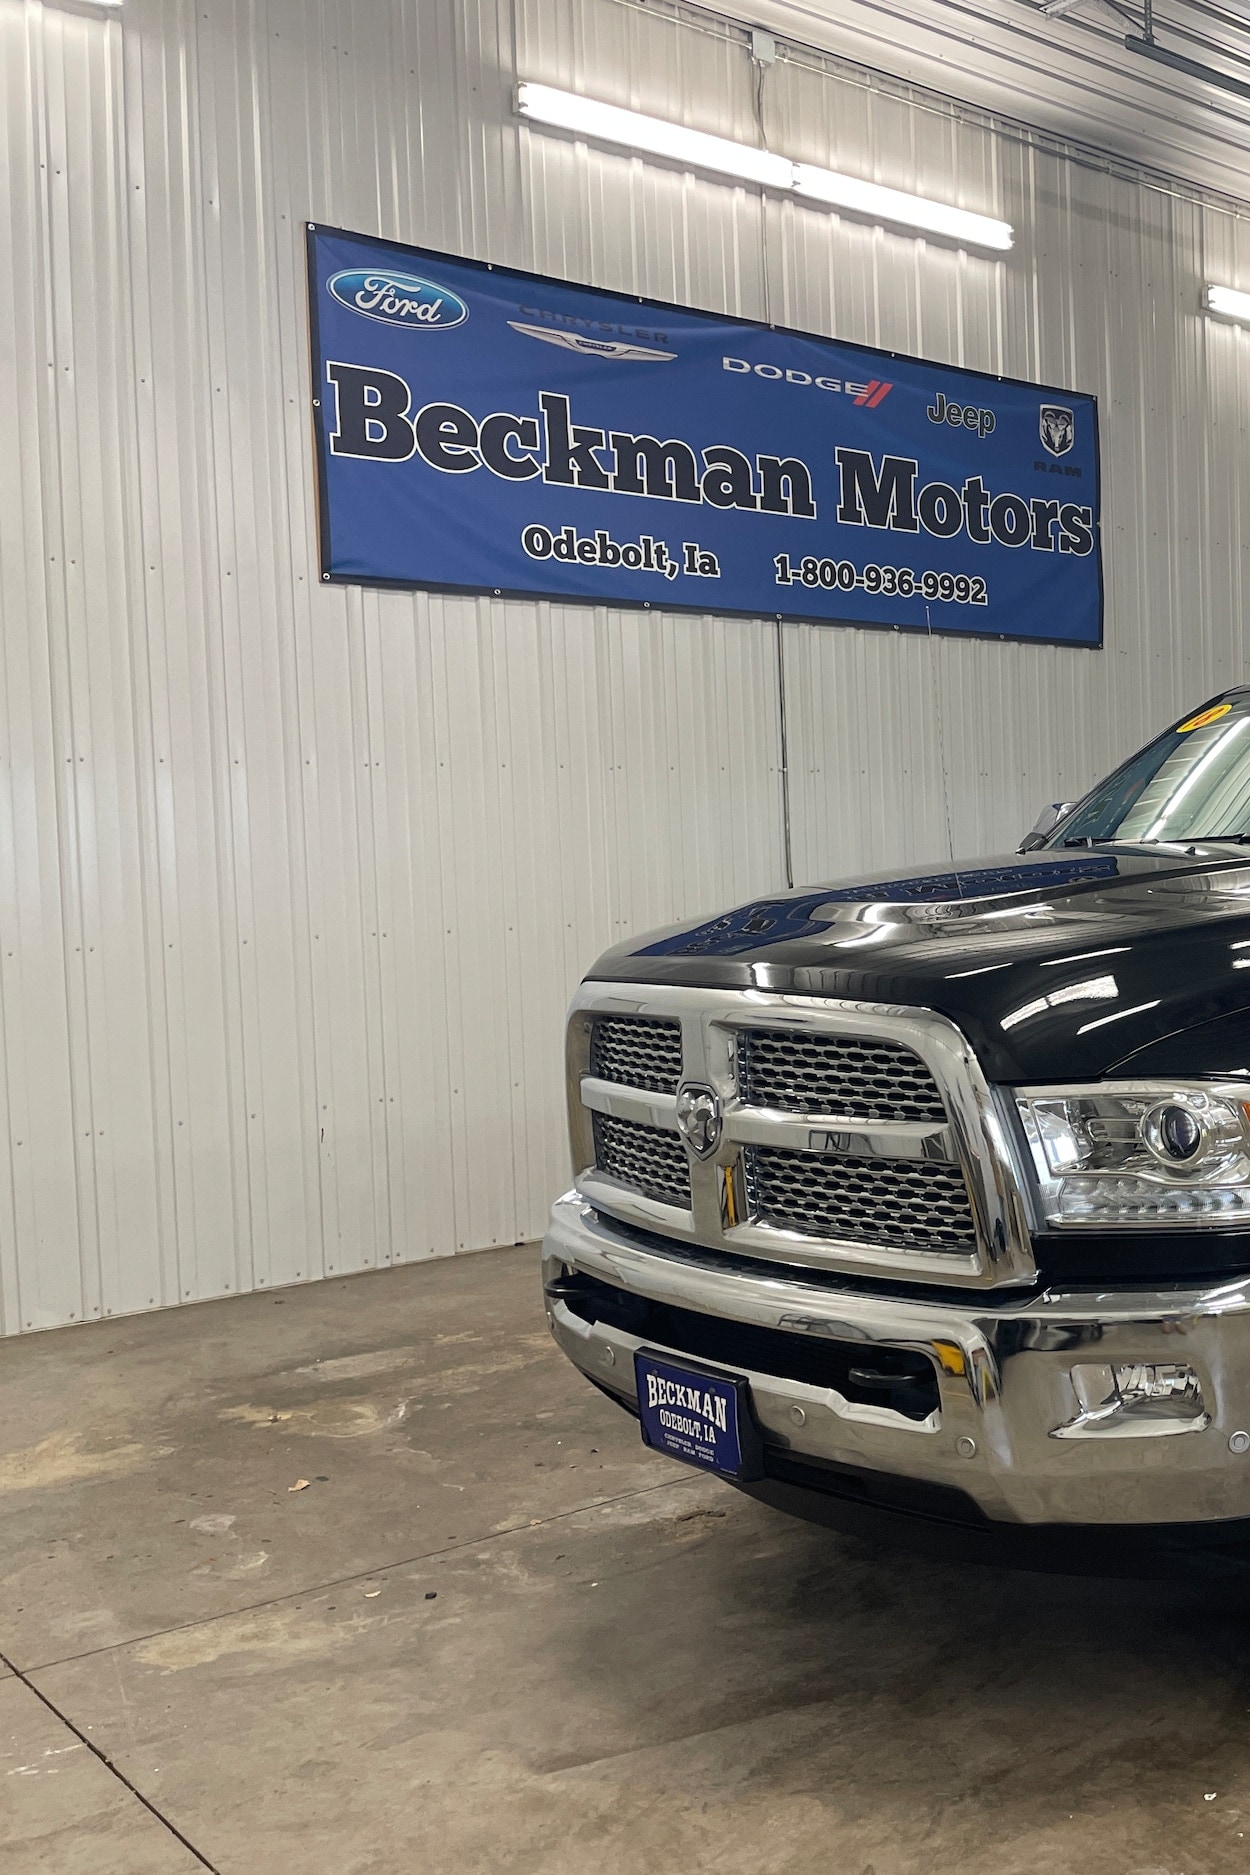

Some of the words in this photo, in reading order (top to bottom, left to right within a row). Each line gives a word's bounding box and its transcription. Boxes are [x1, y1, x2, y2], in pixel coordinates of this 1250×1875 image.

[354, 274, 442, 323] Ford
[519, 304, 669, 344] CHRYSLER
[722, 356, 868, 397] DODGE
[926, 392, 996, 438] Jeep
[326, 360, 817, 520] Beckman
[834, 446, 1094, 557] Motors
[1033, 460, 1083, 478] RAM
[521, 523, 679, 582] Odebolt,
[683, 541, 721, 579] Ia
[773, 553, 989, 606] 1-800-936-9992
[646, 1373, 727, 1433] BECKMAN
[659, 1408, 703, 1442] ODEBOLT,
[703, 1424, 717, 1444] IA
